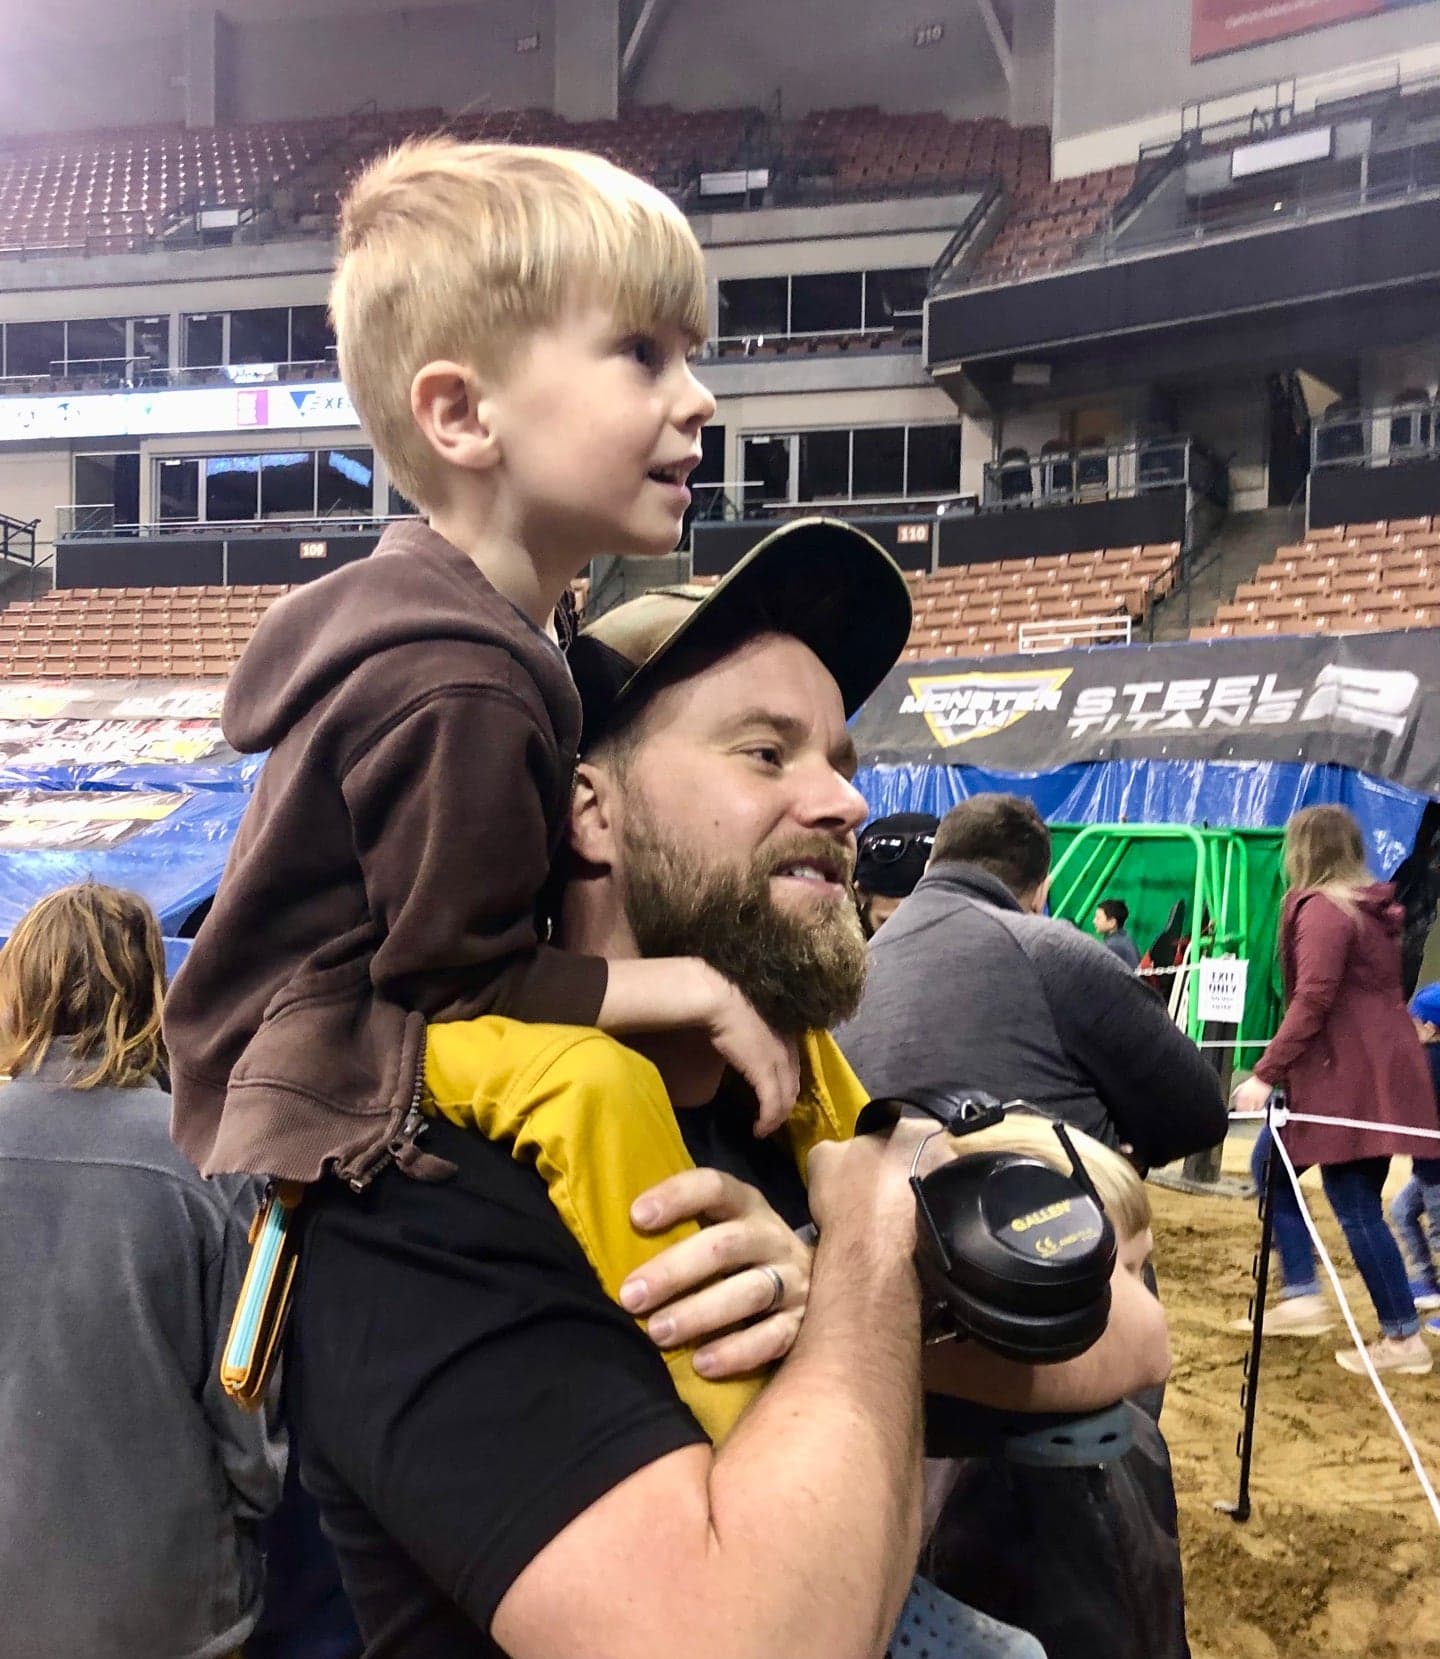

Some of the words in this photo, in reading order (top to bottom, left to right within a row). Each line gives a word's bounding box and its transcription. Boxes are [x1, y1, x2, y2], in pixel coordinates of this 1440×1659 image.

[901, 525, 926, 541] 110
[303, 543, 324, 556] 109
[898, 689, 1063, 714] MONSTER
[1073, 674, 1302, 716] STEEL
[1300, 663, 1419, 737] 2
[936, 708, 1010, 727] JAM
[1067, 701, 1297, 739] TITANS
[1210, 971, 1235, 982] EXIT
[1208, 983, 1238, 993] ONLY
